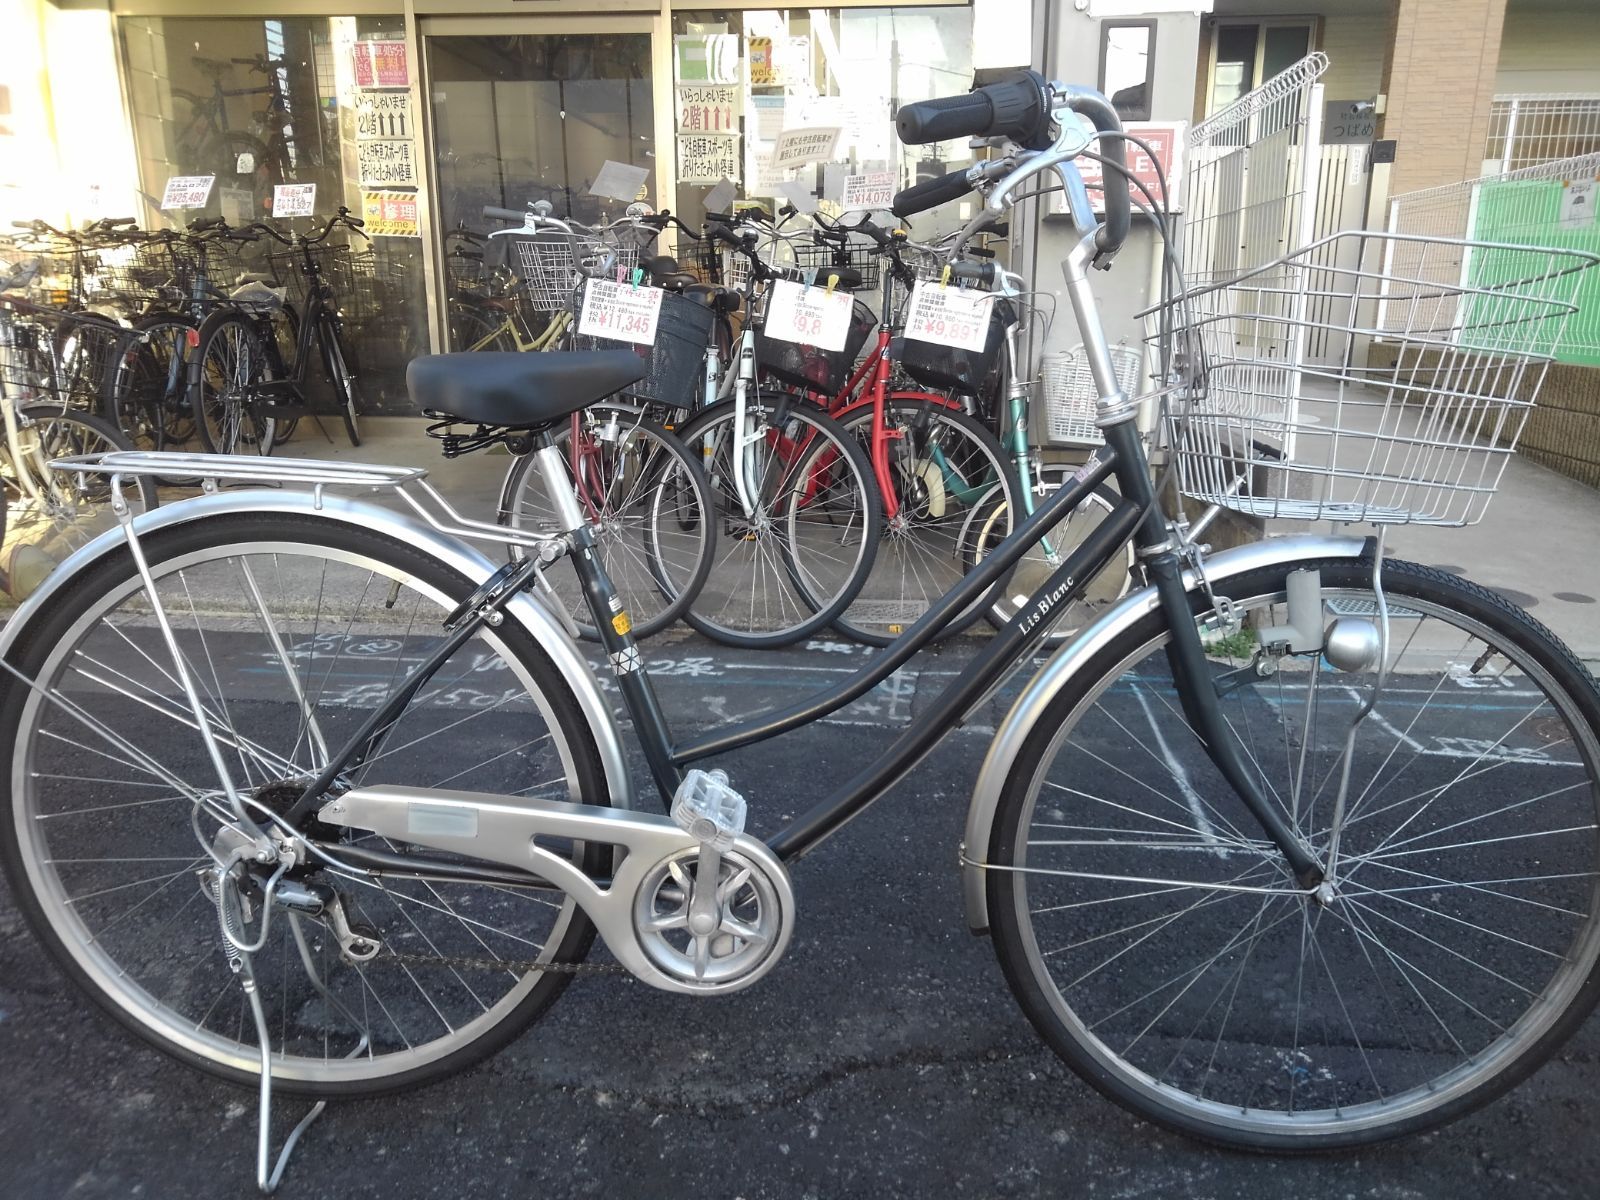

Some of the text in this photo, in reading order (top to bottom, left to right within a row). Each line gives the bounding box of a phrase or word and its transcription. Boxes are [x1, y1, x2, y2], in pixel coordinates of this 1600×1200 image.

[680, 88, 734, 103] いらっしゃいませ
[682, 104, 701, 130] 2階
[1333, 123, 1374, 137] つばめ
[1129, 182, 1159, 192] OF!
[855, 191, 891, 204] ¥14,073
[599, 311, 650, 333] ¥11,345
[1018, 576, 1074, 636] Lis Blanc
